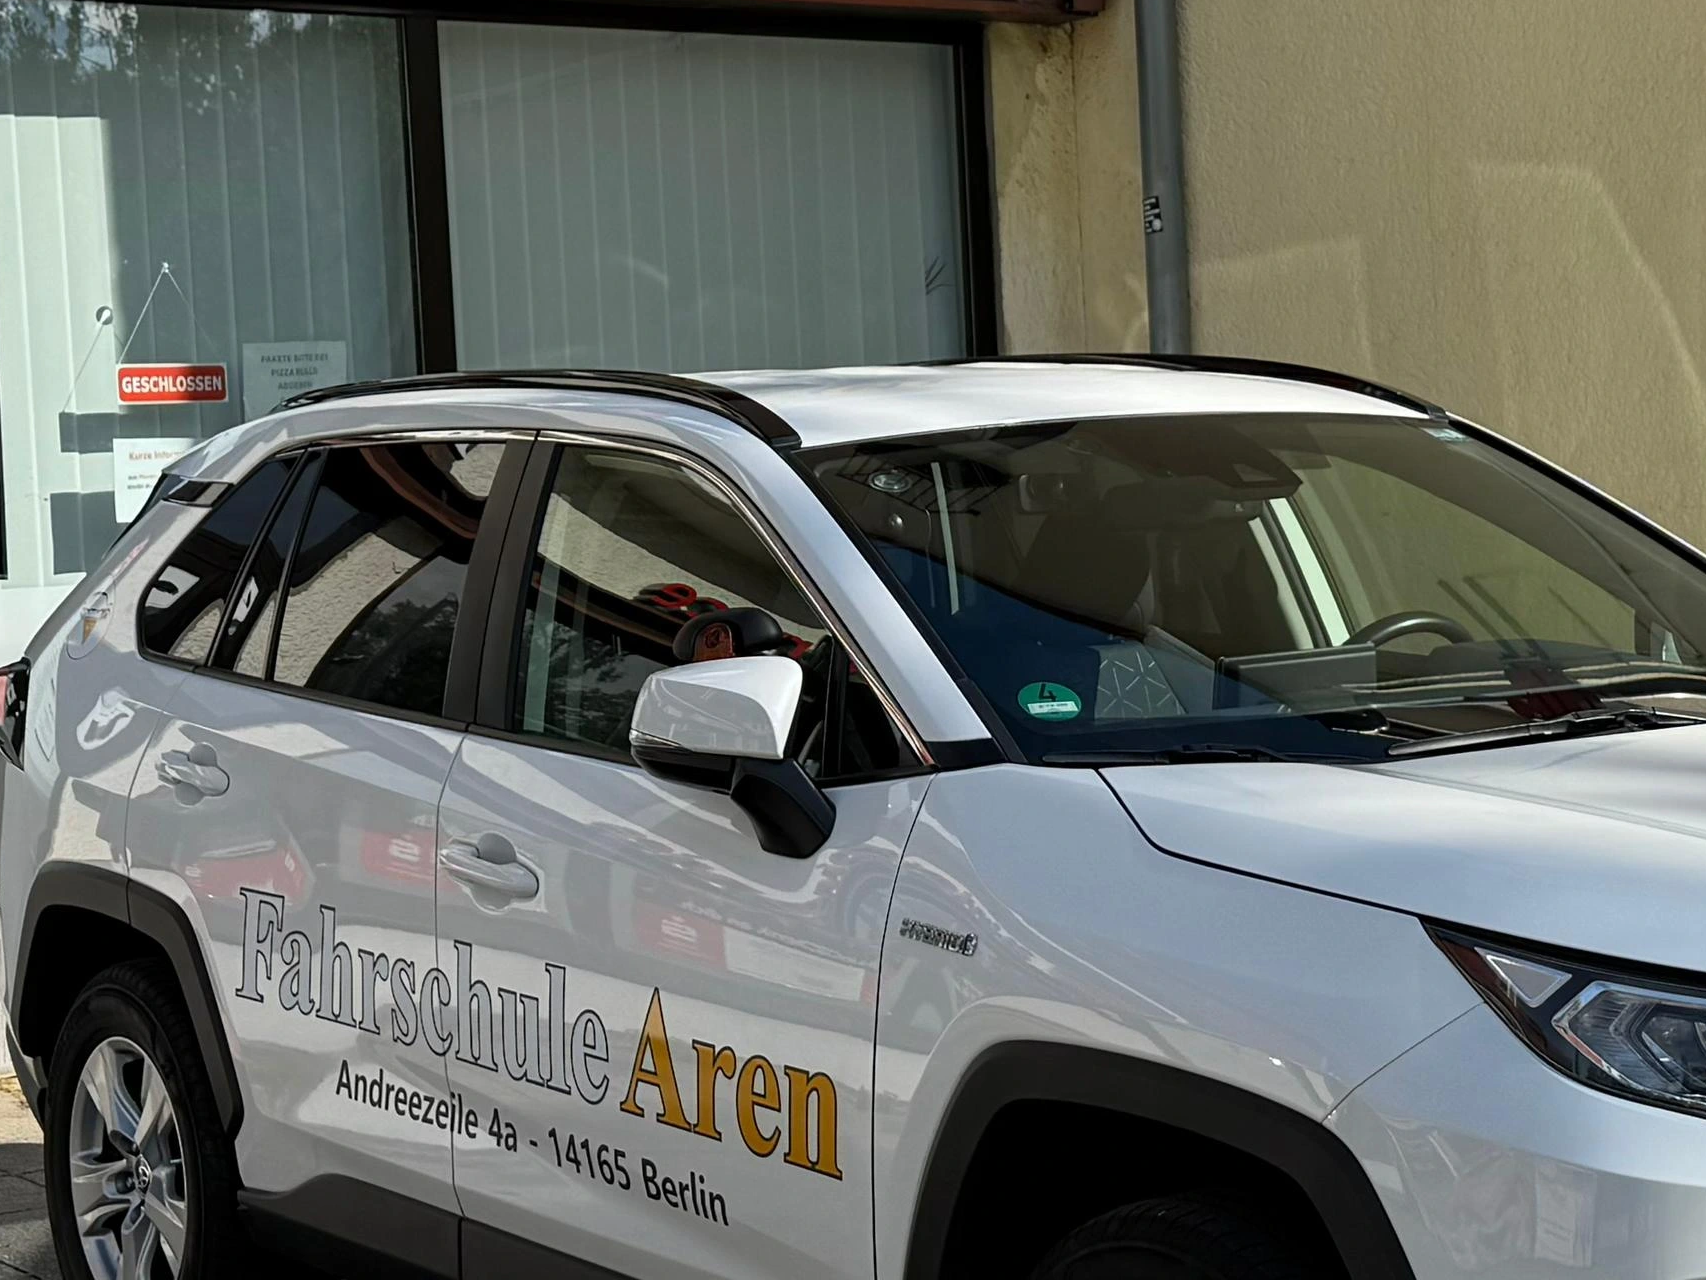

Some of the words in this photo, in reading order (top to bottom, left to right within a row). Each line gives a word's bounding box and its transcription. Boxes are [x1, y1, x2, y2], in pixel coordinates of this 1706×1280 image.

[121, 375, 223, 394] GESCHLOSSEN
[235, 886, 611, 1106] Fahrschule
[619, 986, 844, 1181] Aren
[335, 1059, 480, 1141] Andreezeile
[487, 1107, 519, 1154] 4a
[547, 1126, 631, 1191] 14165
[641, 1158, 730, 1228] Berlin
